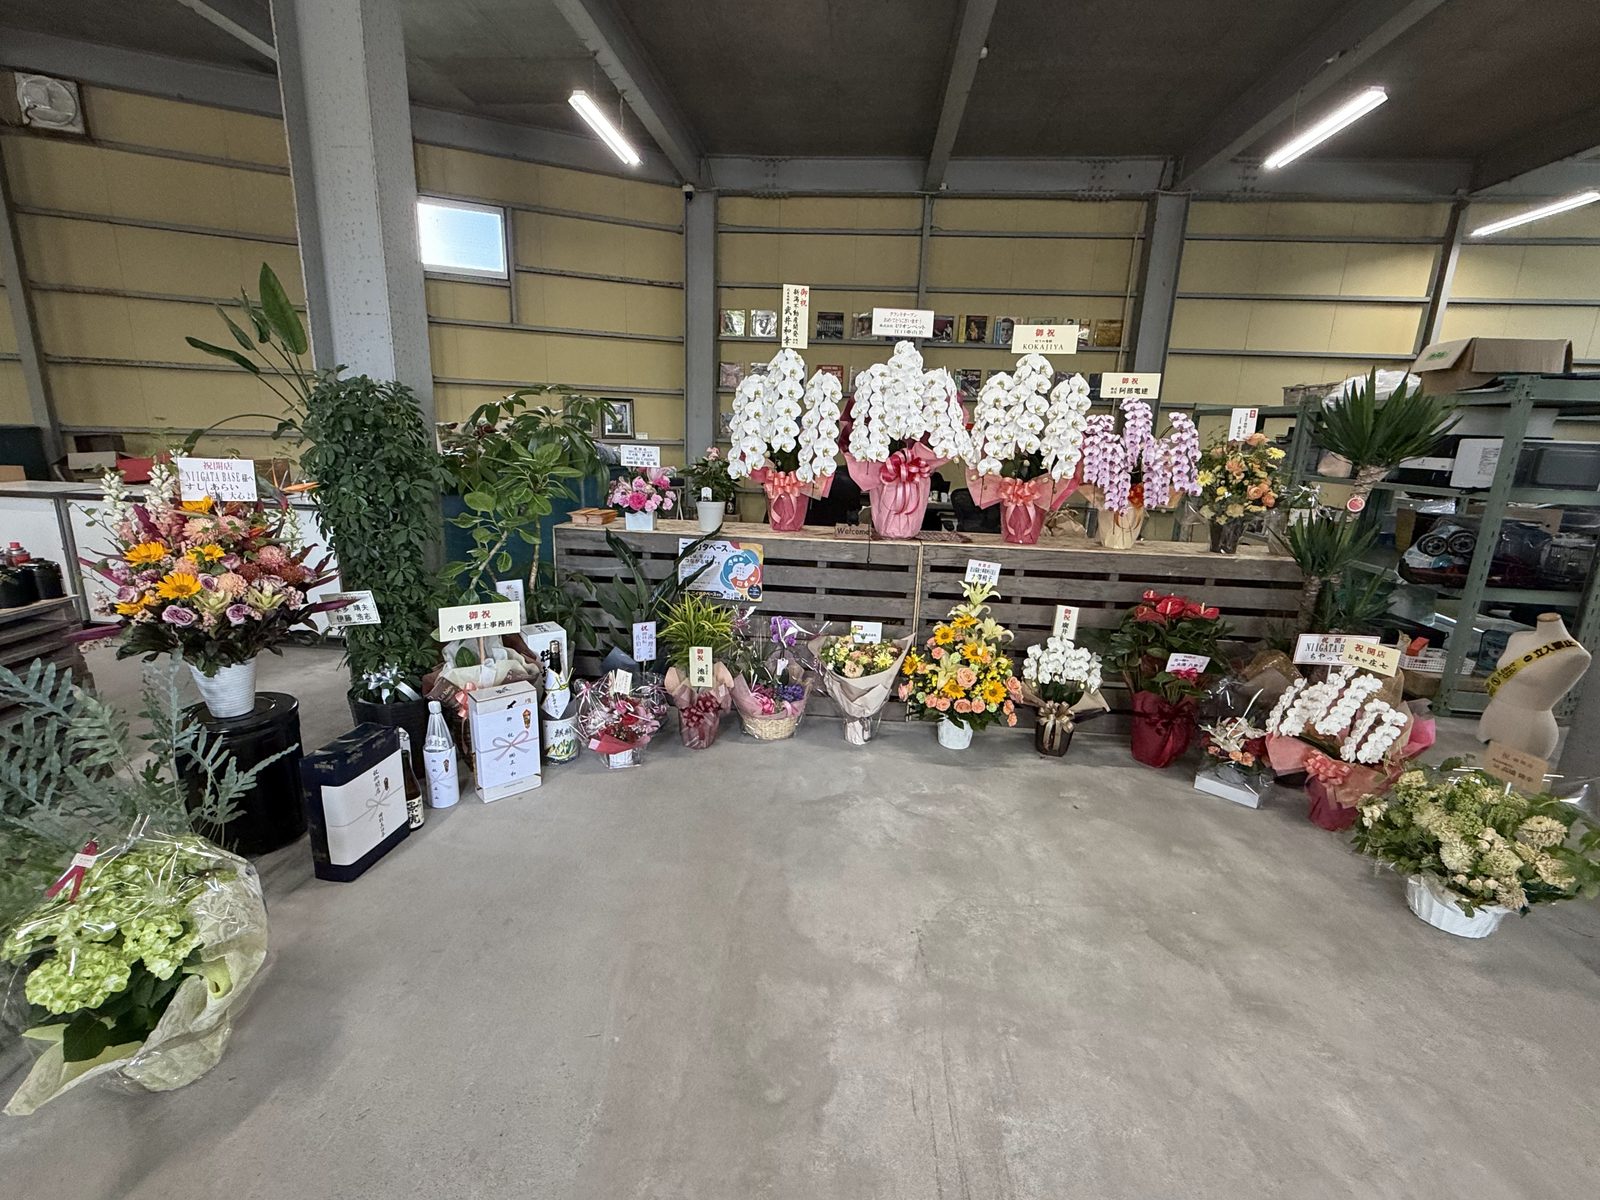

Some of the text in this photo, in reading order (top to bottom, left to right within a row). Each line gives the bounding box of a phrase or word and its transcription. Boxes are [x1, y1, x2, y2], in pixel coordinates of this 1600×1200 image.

[800, 288, 808, 306] 御祝
[1036, 328, 1055, 337] 御祝
[203, 462, 233, 470] 祝開店
[186, 472, 220, 482] NIIGATA
[222, 472, 240, 482] BASE
[185, 482, 239, 491] すし あらい
[682, 542, 728, 552] ニタベース
[468, 610, 491, 620] 御祝
[1064, 608, 1071, 621] 御祝
[448, 619, 513, 633] 小菅税理士事務所
[1305, 643, 1338, 652] NIIGATA
[1355, 644, 1386, 658] 祝開店
[1533, 640, 1576, 658] 立入禁止
[697, 649, 704, 661] 御祝
